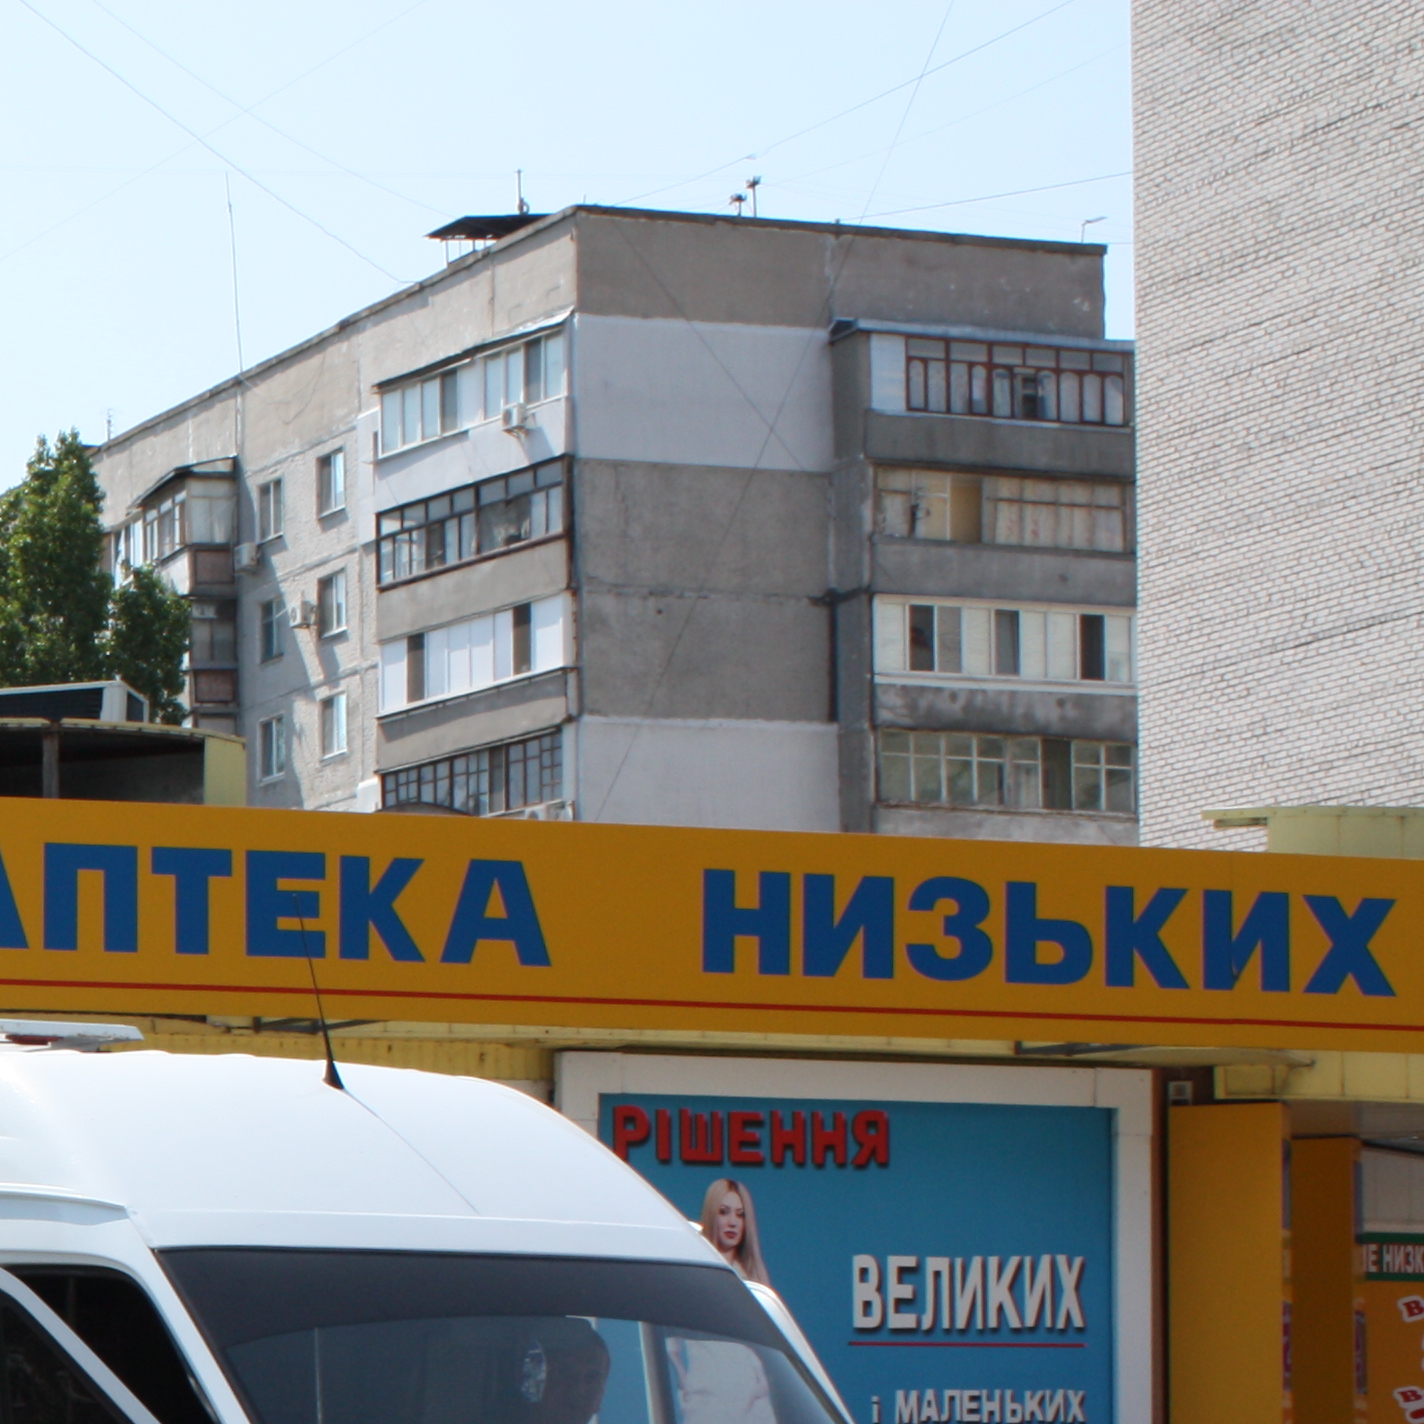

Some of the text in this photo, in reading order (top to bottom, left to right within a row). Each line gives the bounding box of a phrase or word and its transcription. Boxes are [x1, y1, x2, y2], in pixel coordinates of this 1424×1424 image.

[701, 867, 1398, 998] НИЗЬКИХ
[612, 1105, 889, 1166] РІШЕННЯ
[852, 1253, 1087, 1332] ВЕЛИКИХ
